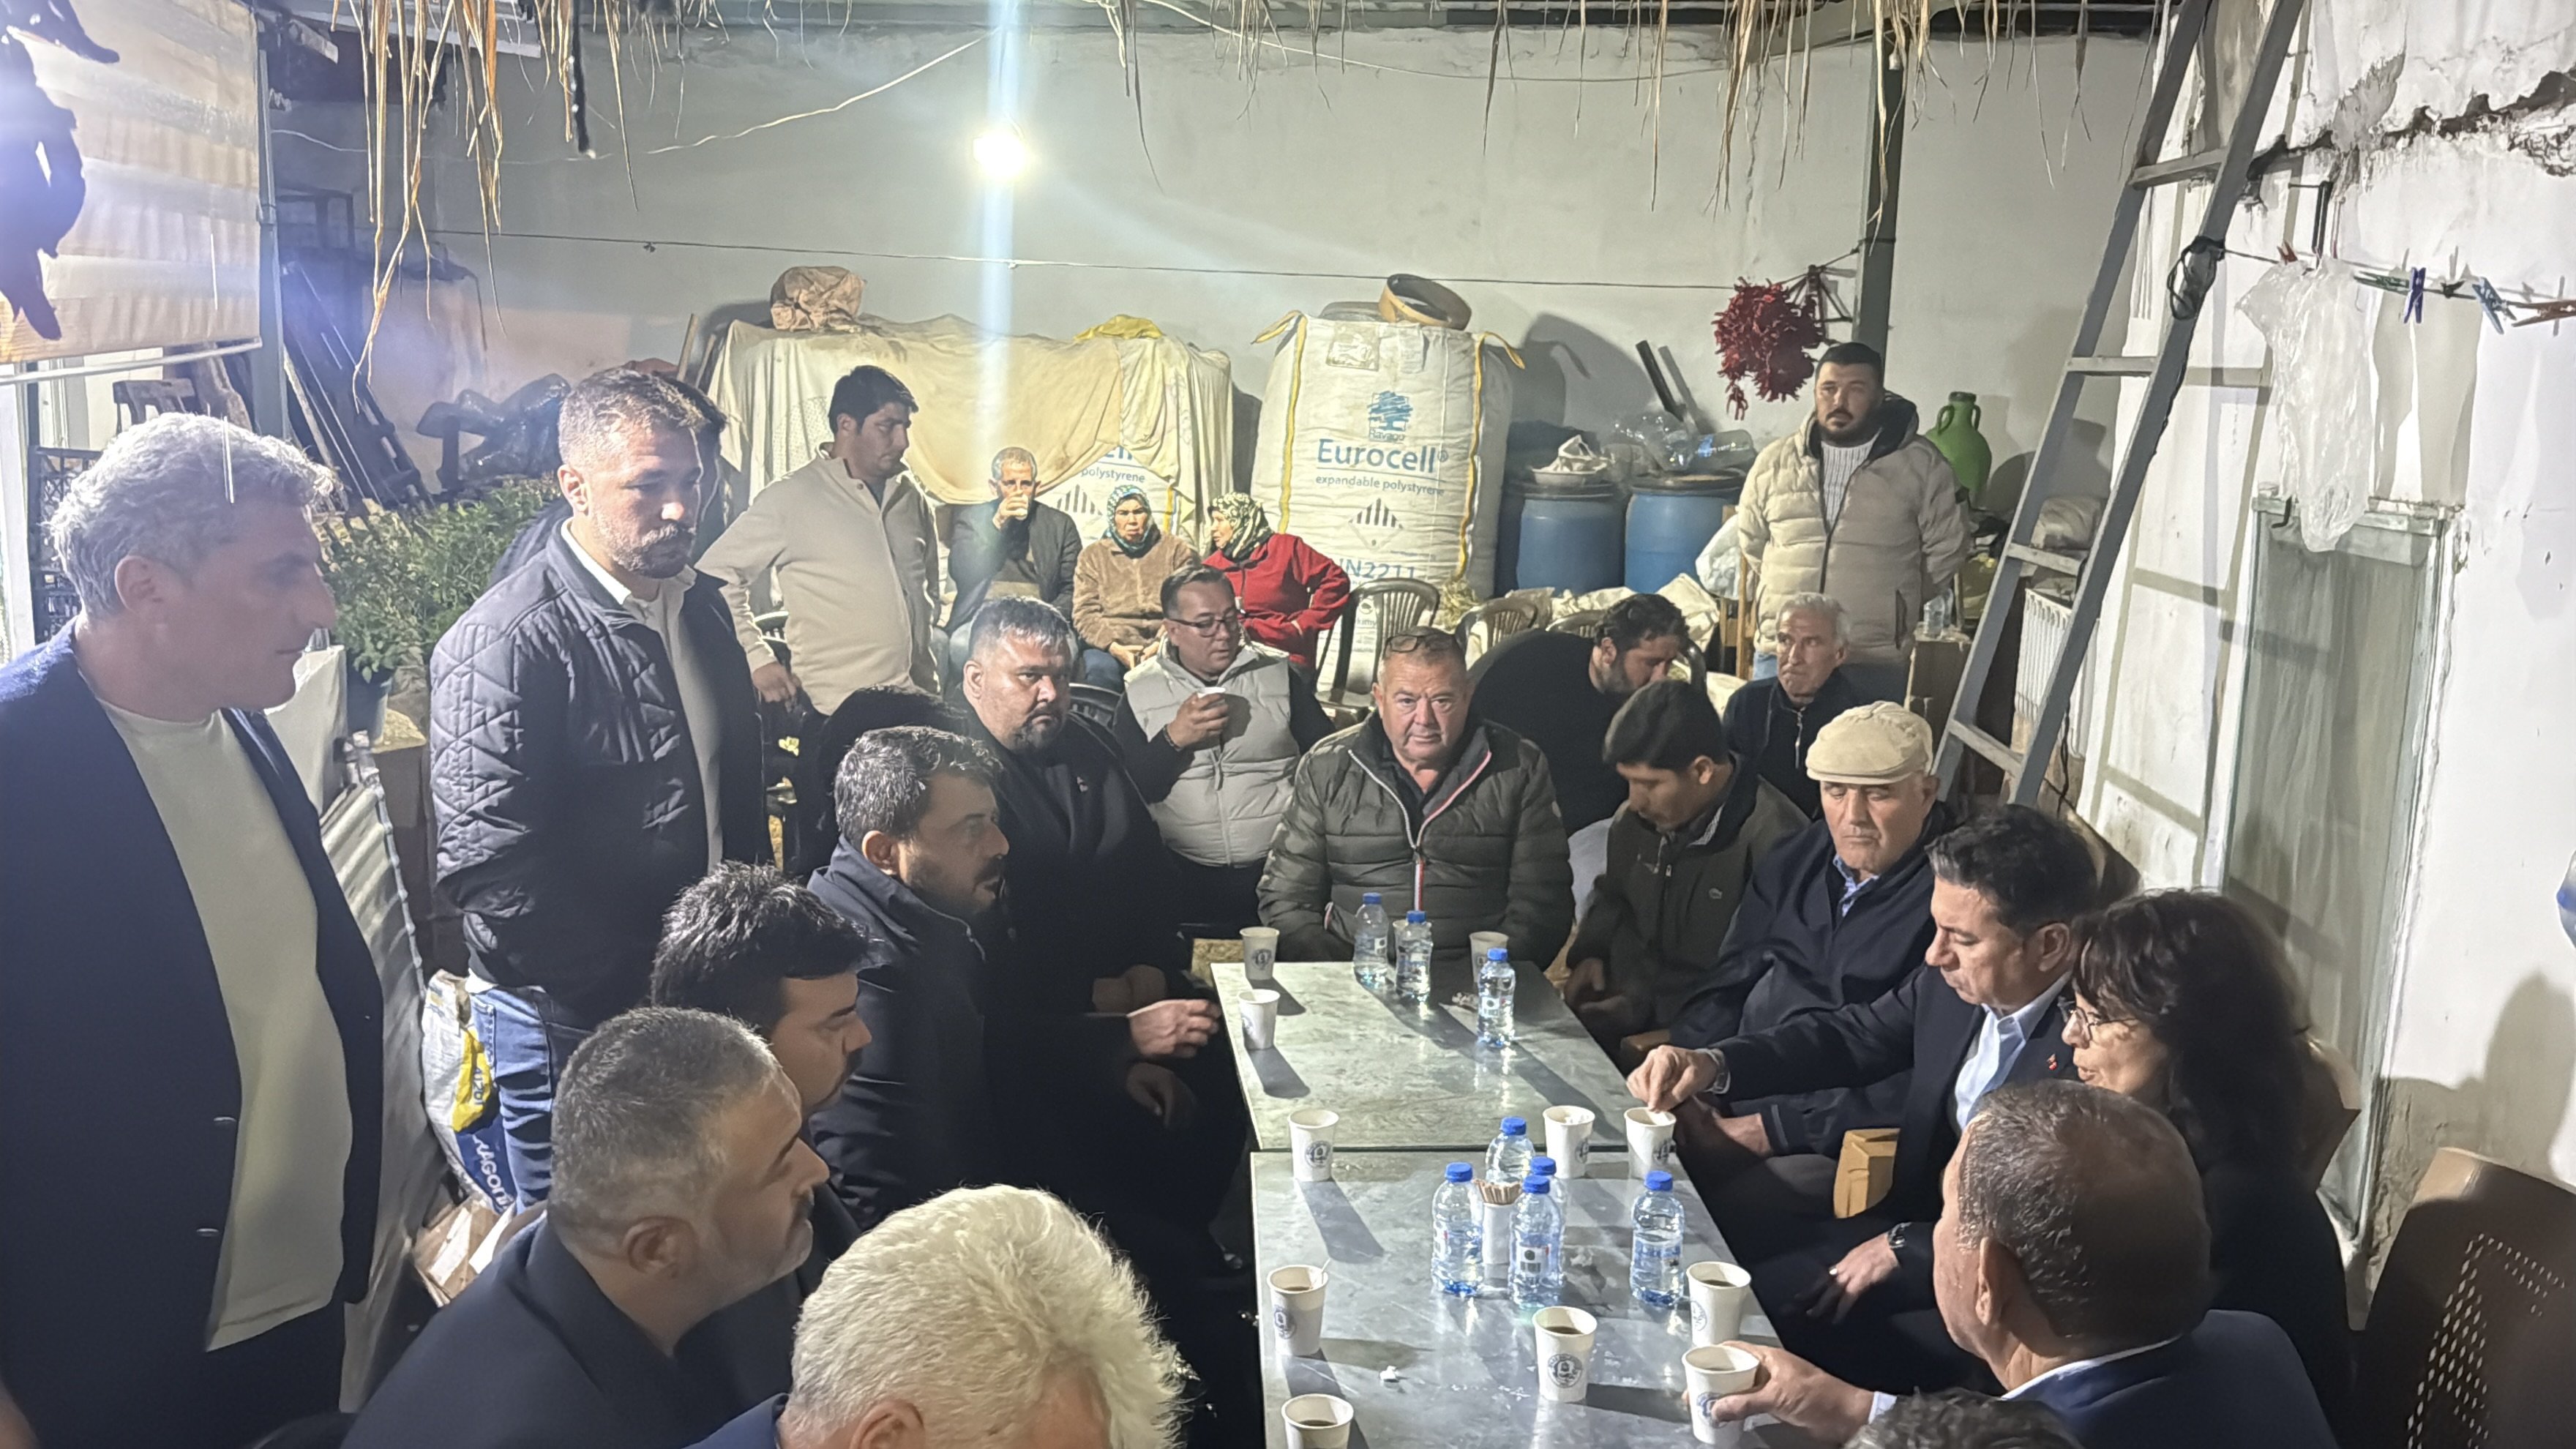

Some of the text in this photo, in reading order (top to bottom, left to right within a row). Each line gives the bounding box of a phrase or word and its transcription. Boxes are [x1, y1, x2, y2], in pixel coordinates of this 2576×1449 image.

[1081, 467, 1145, 483] polystyrene
[1315, 475, 1445, 495] expandable polystyrene
